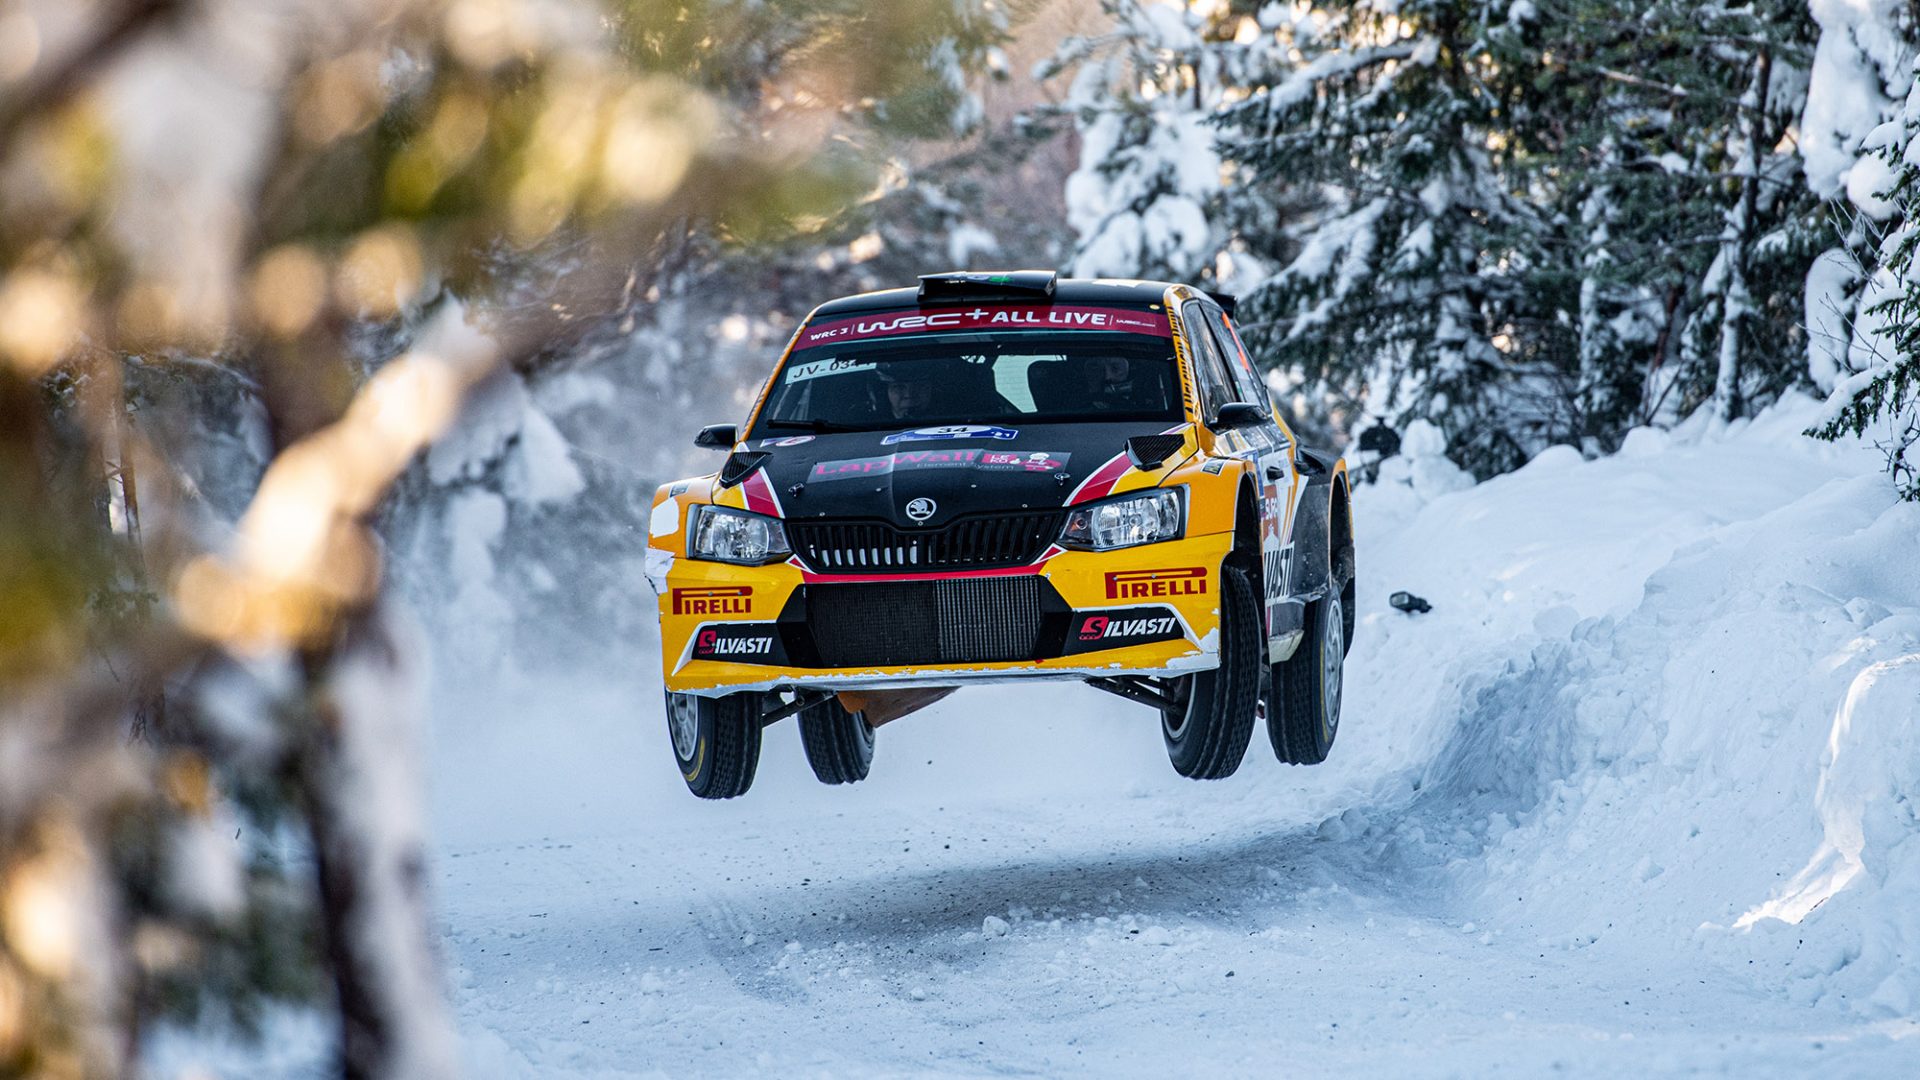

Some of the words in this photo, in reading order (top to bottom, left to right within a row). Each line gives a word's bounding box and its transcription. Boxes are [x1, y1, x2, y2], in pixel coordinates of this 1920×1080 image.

[991, 311, 1040, 323] ALL
[1048, 311, 1107, 326] LIVE
[810, 329, 838, 341] WRC
[839, 327, 849, 335] 3
[937, 426, 968, 434] 34
[816, 451, 975, 475] LapWall
[1105, 567, 1208, 599] PIRELLI
[672, 586, 753, 615] PIRELLI
[1079, 616, 1176, 640] SILVASTI
[698, 630, 773, 654] SILVASTI
